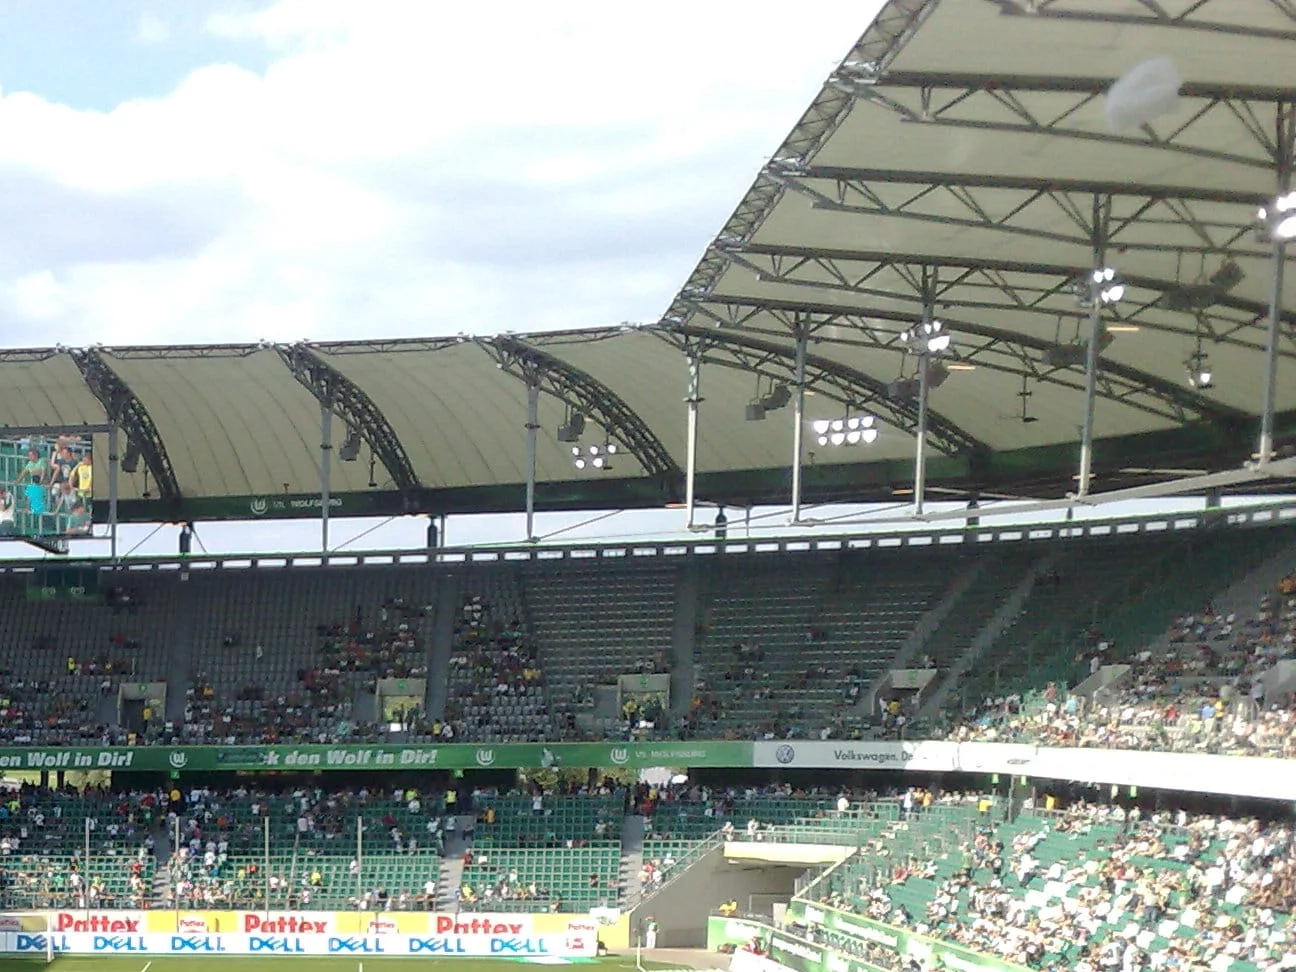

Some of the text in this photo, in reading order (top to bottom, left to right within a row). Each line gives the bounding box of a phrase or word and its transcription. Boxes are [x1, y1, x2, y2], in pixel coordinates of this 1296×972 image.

[27, 752, 71, 767] Wolf
[75, 752, 92, 767] in
[97, 752, 134, 767] Dir!
[284, 750, 320, 765] den
[327, 750, 371, 765] Wolf
[375, 750, 394, 764] in
[400, 749, 438, 764] Dir!
[58, 913, 140, 932] Pattex
[244, 914, 328, 933] Pattex
[436, 915, 524, 934] Pattex
[16, 934, 71, 951] DELL
[93, 935, 148, 951] DELL
[171, 936, 225, 951] DELL
[249, 936, 304, 952] DELL
[328, 937, 385, 952] DELL
[409, 937, 465, 952] DELL
[490, 937, 549, 953] DELL
